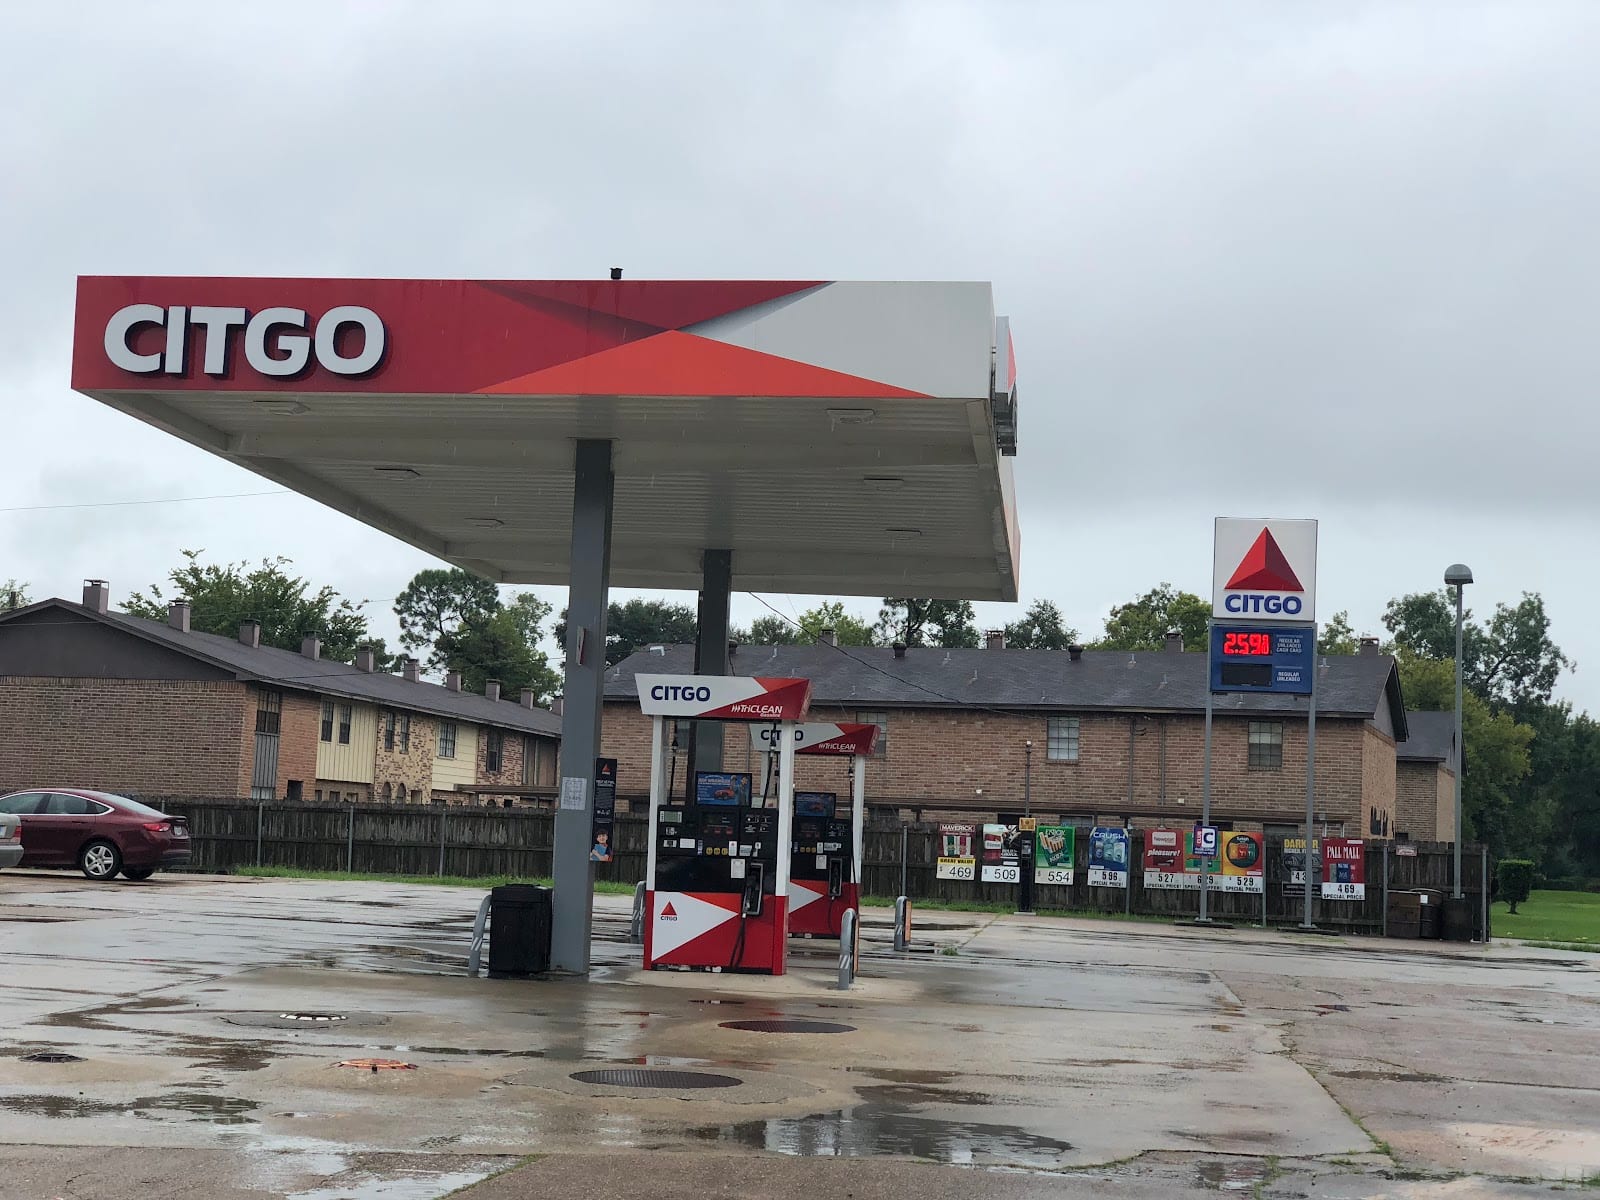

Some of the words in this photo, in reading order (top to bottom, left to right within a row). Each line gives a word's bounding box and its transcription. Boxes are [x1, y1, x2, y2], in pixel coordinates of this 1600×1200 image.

[103, 303, 386, 377] CITGO
[1225, 594, 1302, 614] CITGO
[651, 685, 711, 702] CITGO
[1094, 832, 1124, 840] CRUSH
[1284, 838, 1319, 849] DARKR
[1327, 846, 1342, 859] PALL
[1343, 847, 1361, 860] MALL
